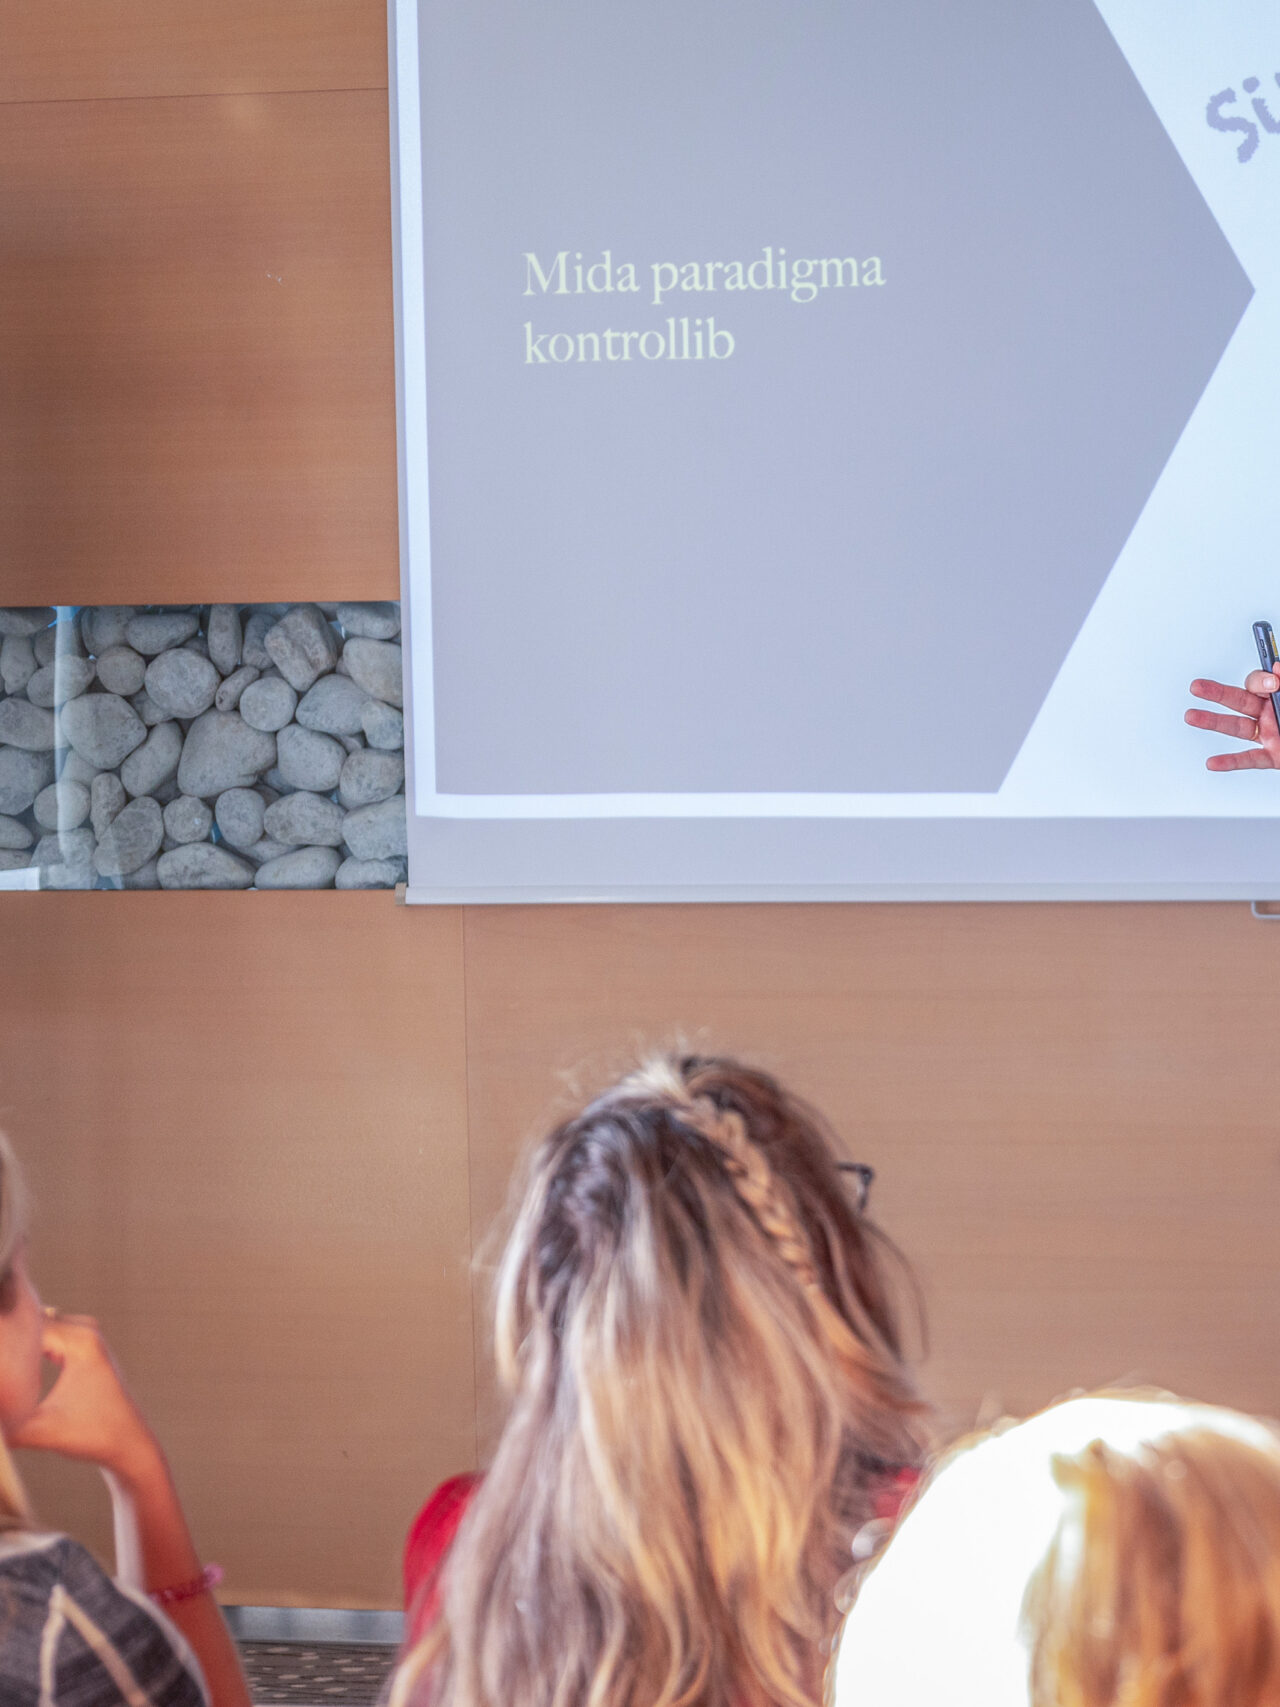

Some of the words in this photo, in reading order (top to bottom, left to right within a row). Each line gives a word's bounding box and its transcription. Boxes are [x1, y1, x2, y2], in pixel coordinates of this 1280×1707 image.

[521, 249, 640, 296] Mida
[650, 246, 887, 305] paradigma
[523, 316, 735, 364] kontrollib
